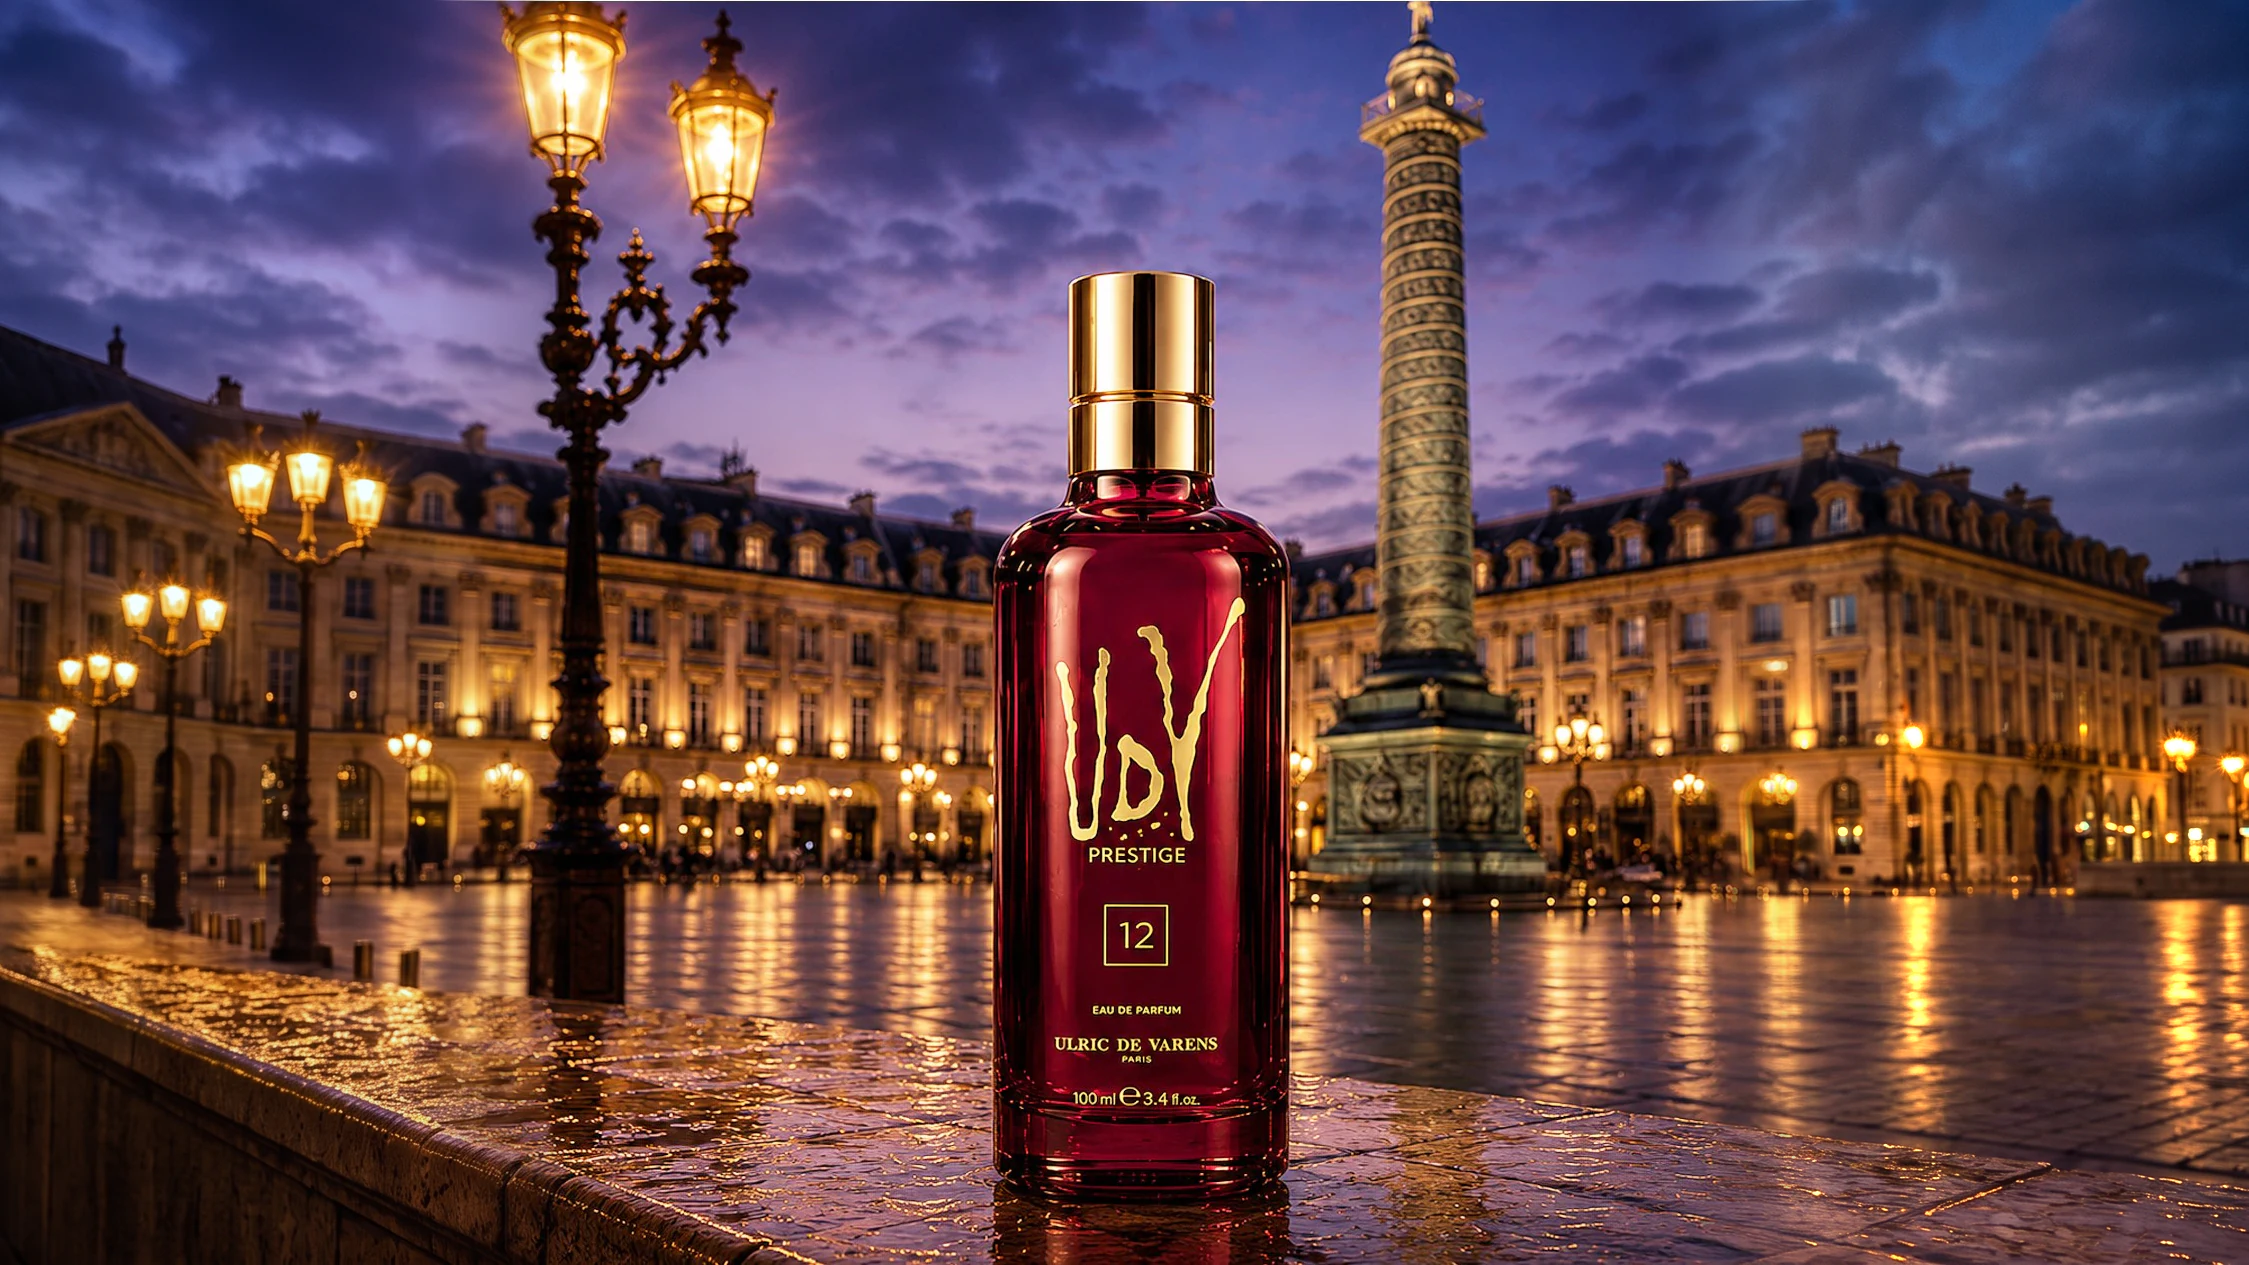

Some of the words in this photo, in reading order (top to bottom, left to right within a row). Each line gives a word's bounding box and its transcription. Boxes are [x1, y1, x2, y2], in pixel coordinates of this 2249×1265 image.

[1088, 847, 1186, 863] PRESTIGE
[1119, 921, 1154, 949] 12
[1092, 1005, 1114, 1015] EAU
[1118, 1005, 1132, 1015] DE
[1136, 1005, 1181, 1015] PARFUM
[1054, 1037, 1109, 1052] ULRIC
[1117, 1038, 1141, 1052] DE
[1149, 1037, 1218, 1051] VARENS
[1073, 1092, 1097, 1106] 100
[1100, 1092, 1116, 1106] ml
[1143, 1092, 1168, 1106] 3.4
